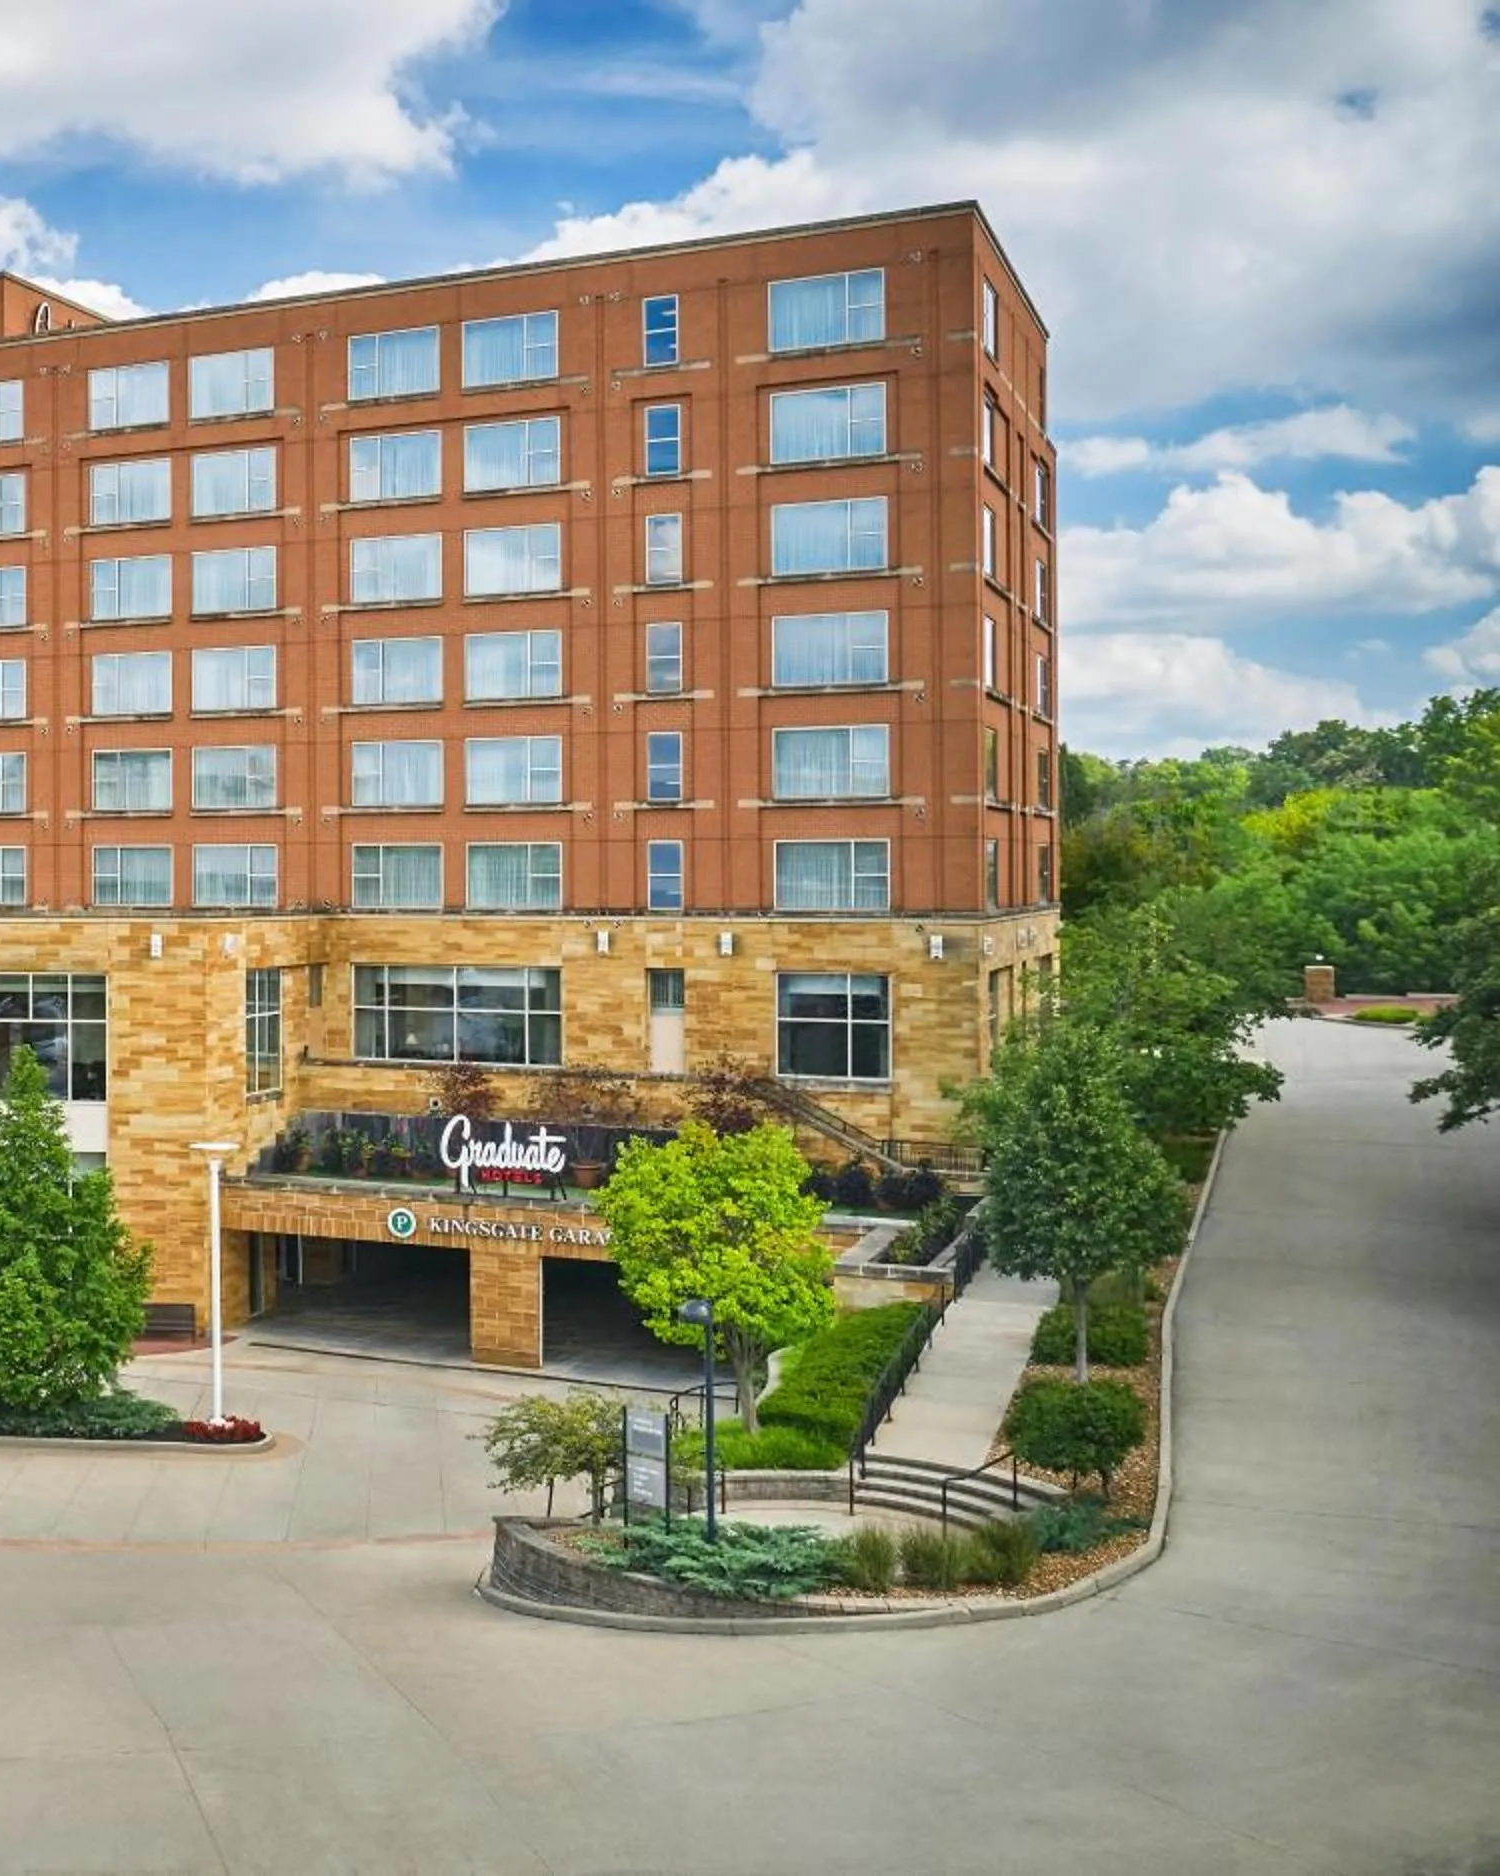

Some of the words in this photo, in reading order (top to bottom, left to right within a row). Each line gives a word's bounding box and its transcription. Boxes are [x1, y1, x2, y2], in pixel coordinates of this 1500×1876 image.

[440, 1114, 567, 1188] Graduate
[479, 1169, 543, 1185] HOTELS
[429, 1216, 543, 1241] KINGSGATE
[548, 1226, 613, 1247] GARA
